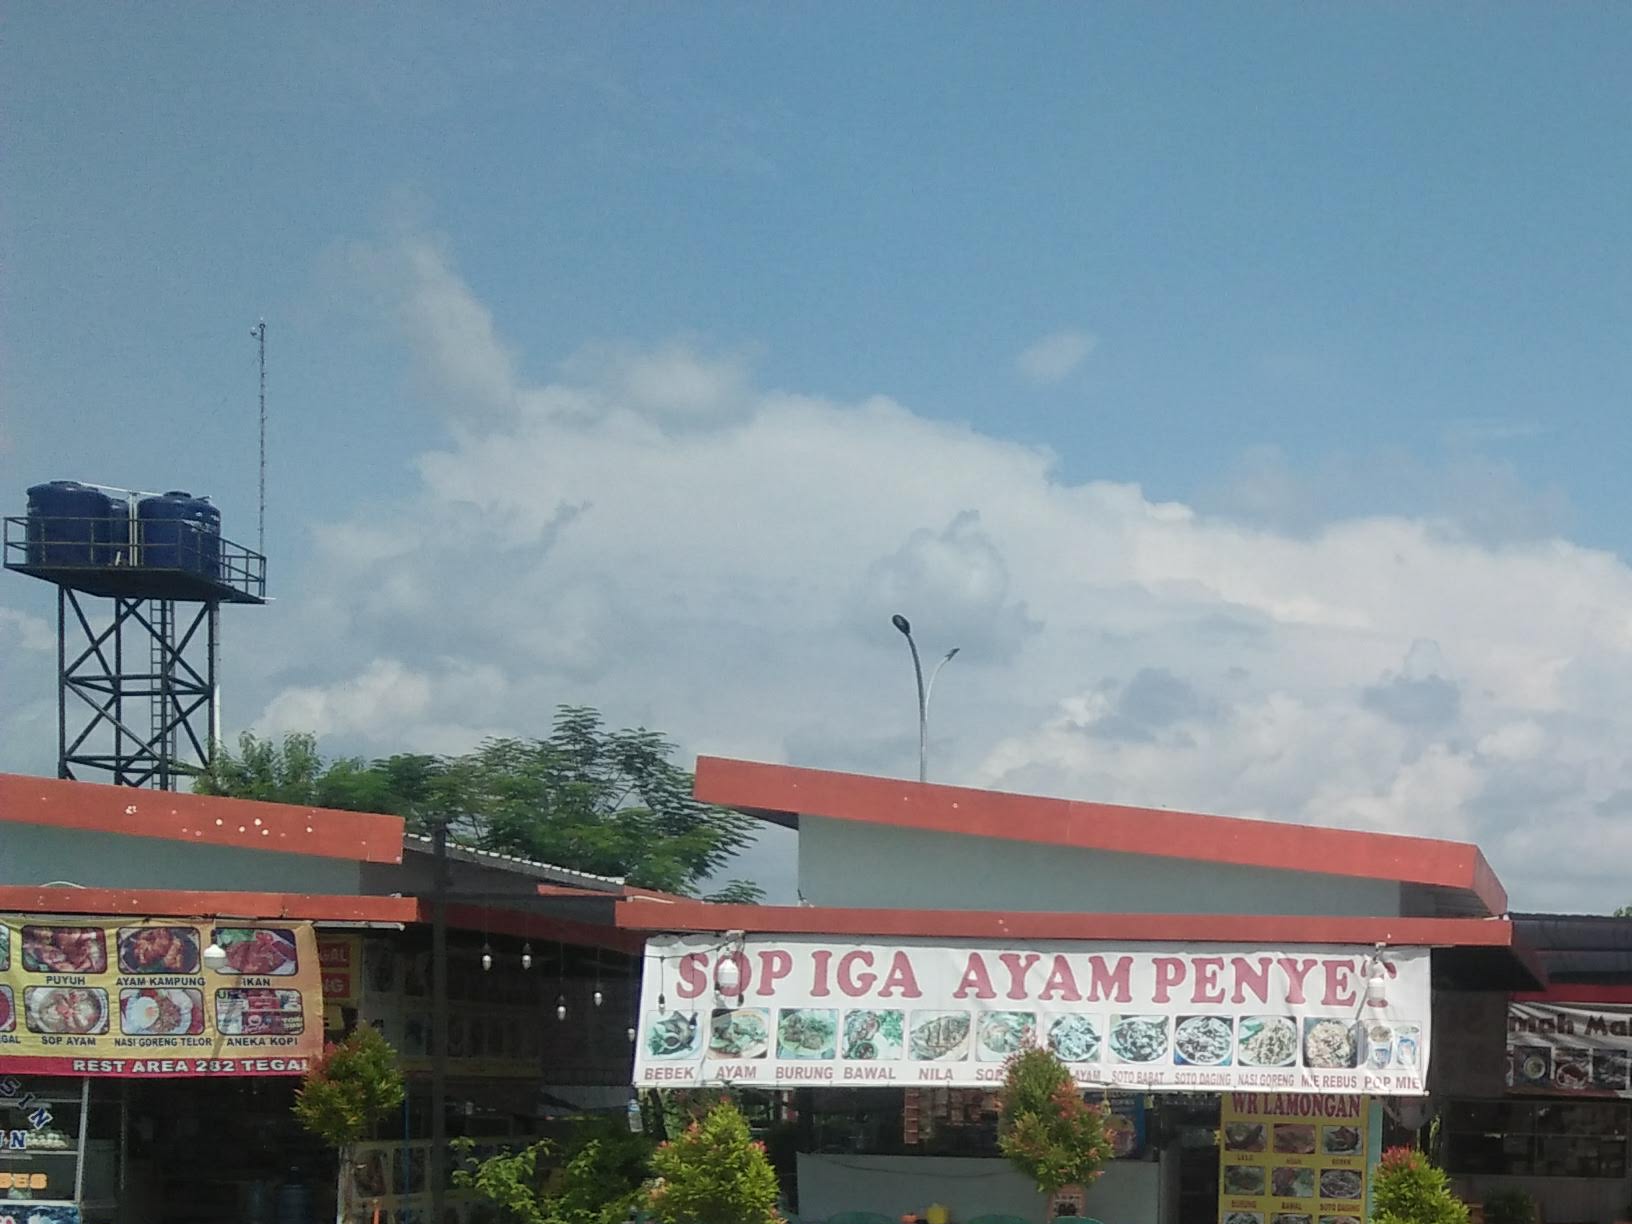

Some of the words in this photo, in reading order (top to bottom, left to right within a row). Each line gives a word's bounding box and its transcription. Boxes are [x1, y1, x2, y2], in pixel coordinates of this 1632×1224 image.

[46, 975, 86, 985] PUYUH
[115, 977, 146, 986] AYAM
[149, 977, 206, 987] KAMPUNG
[242, 977, 271, 987] IKAN
[676, 949, 793, 999] SOP
[809, 949, 923, 998] IGA
[952, 951, 1134, 1003] AYAM
[41, 1036, 66, 1045] SOP
[66, 1037, 96, 1046] AYAM
[114, 1037, 137, 1047] NASI
[138, 1037, 178, 1047] GORENG
[181, 1037, 212, 1047] TELOR
[226, 1037, 266, 1047] ANEKA
[269, 1037, 298, 1047] KOPI
[73, 1059, 126, 1072] REST
[132, 1059, 189, 1073] AREA
[240, 1059, 308, 1072] TEGAL
[715, 1065, 758, 1079] AYAM
[775, 1065, 834, 1080] BURUNG
[644, 1066, 695, 1081] BEBEK
[843, 1066, 897, 1081] BAWAL
[918, 1067, 954, 1081] NILA
[1112, 1070, 1136, 1084] SOTO
[1137, 1071, 1165, 1086] BABAT
[1175, 1072, 1199, 1085] SOTO
[1199, 1072, 1231, 1086] DAGING
[1238, 1073, 1258, 1087] NASI
[1259, 1073, 1295, 1087] GORENG
[1322, 1075, 1357, 1089] REBUS
[1364, 1075, 1392, 1089] POP
[1395, 1076, 1420, 1089] MIE
[1231, 1091, 1258, 1115] WR
[1263, 1092, 1361, 1118] LAMONGAN
